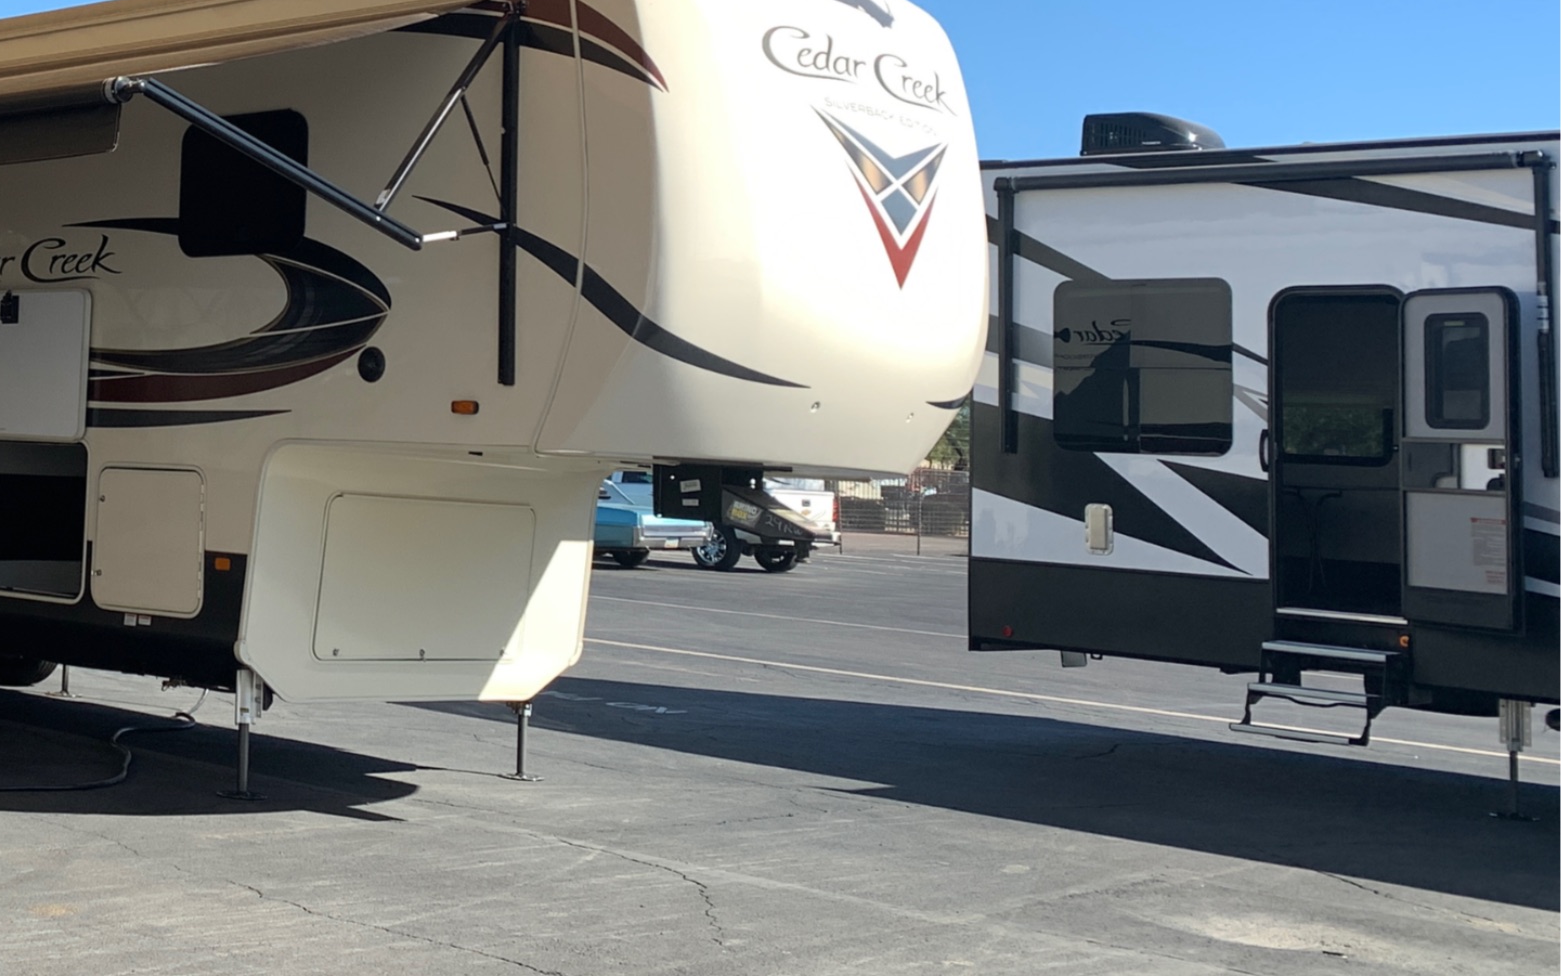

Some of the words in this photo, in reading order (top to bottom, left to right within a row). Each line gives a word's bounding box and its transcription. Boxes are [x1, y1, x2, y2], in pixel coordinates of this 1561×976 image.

[761, 25, 866, 84] Cedar
[874, 53, 958, 116] Creek
[20, 234, 123, 284] Creek
